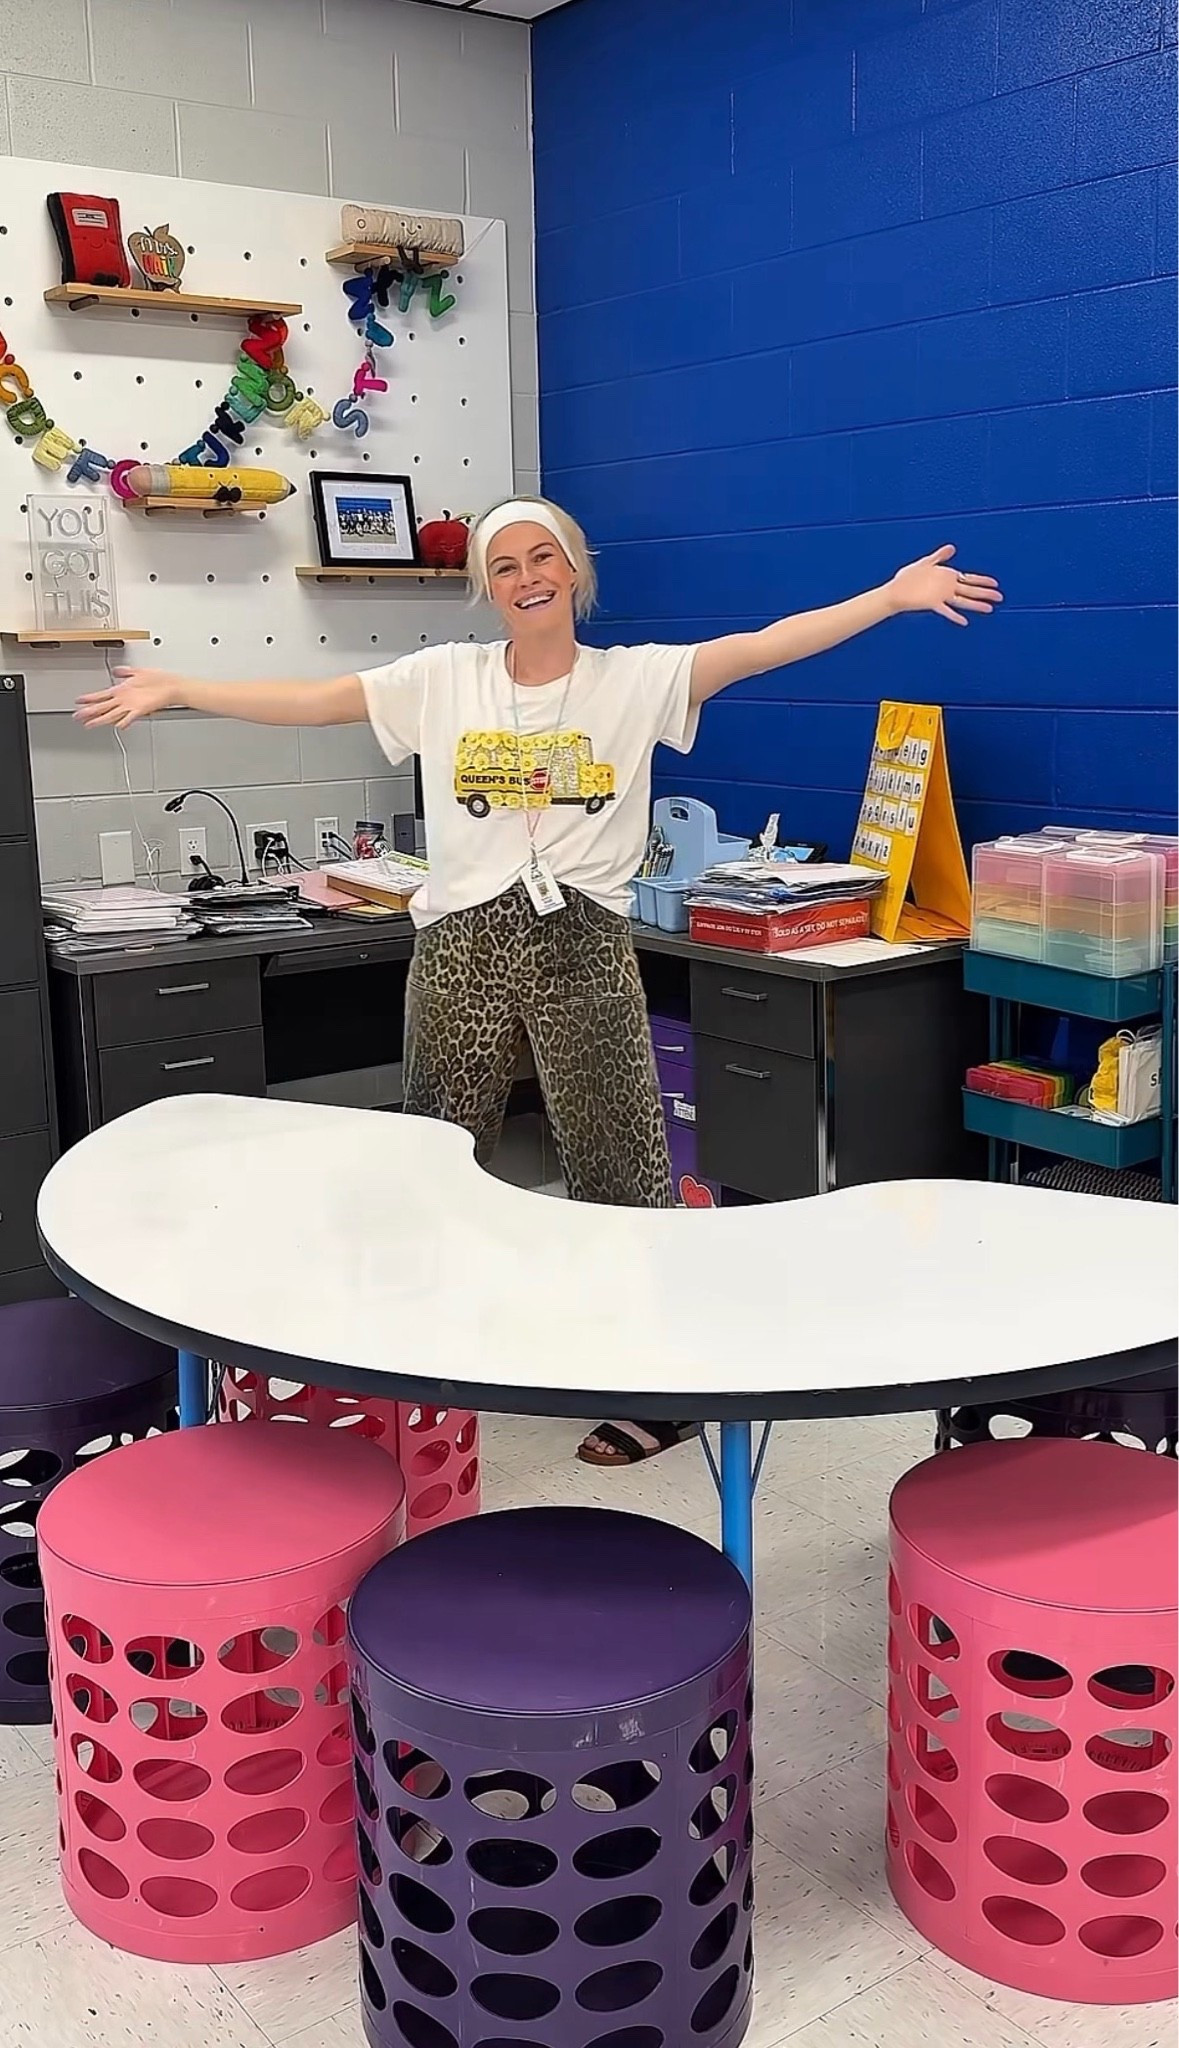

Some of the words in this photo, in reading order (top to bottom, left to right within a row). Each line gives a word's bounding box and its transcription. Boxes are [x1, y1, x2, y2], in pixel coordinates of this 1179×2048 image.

[37, 507, 105, 538] YOU
[42, 548, 107, 578] GOT
[44, 589, 111, 620] THIS
[460, 774, 506, 785] QUEEN'S
[508, 776, 531, 786] BUS
